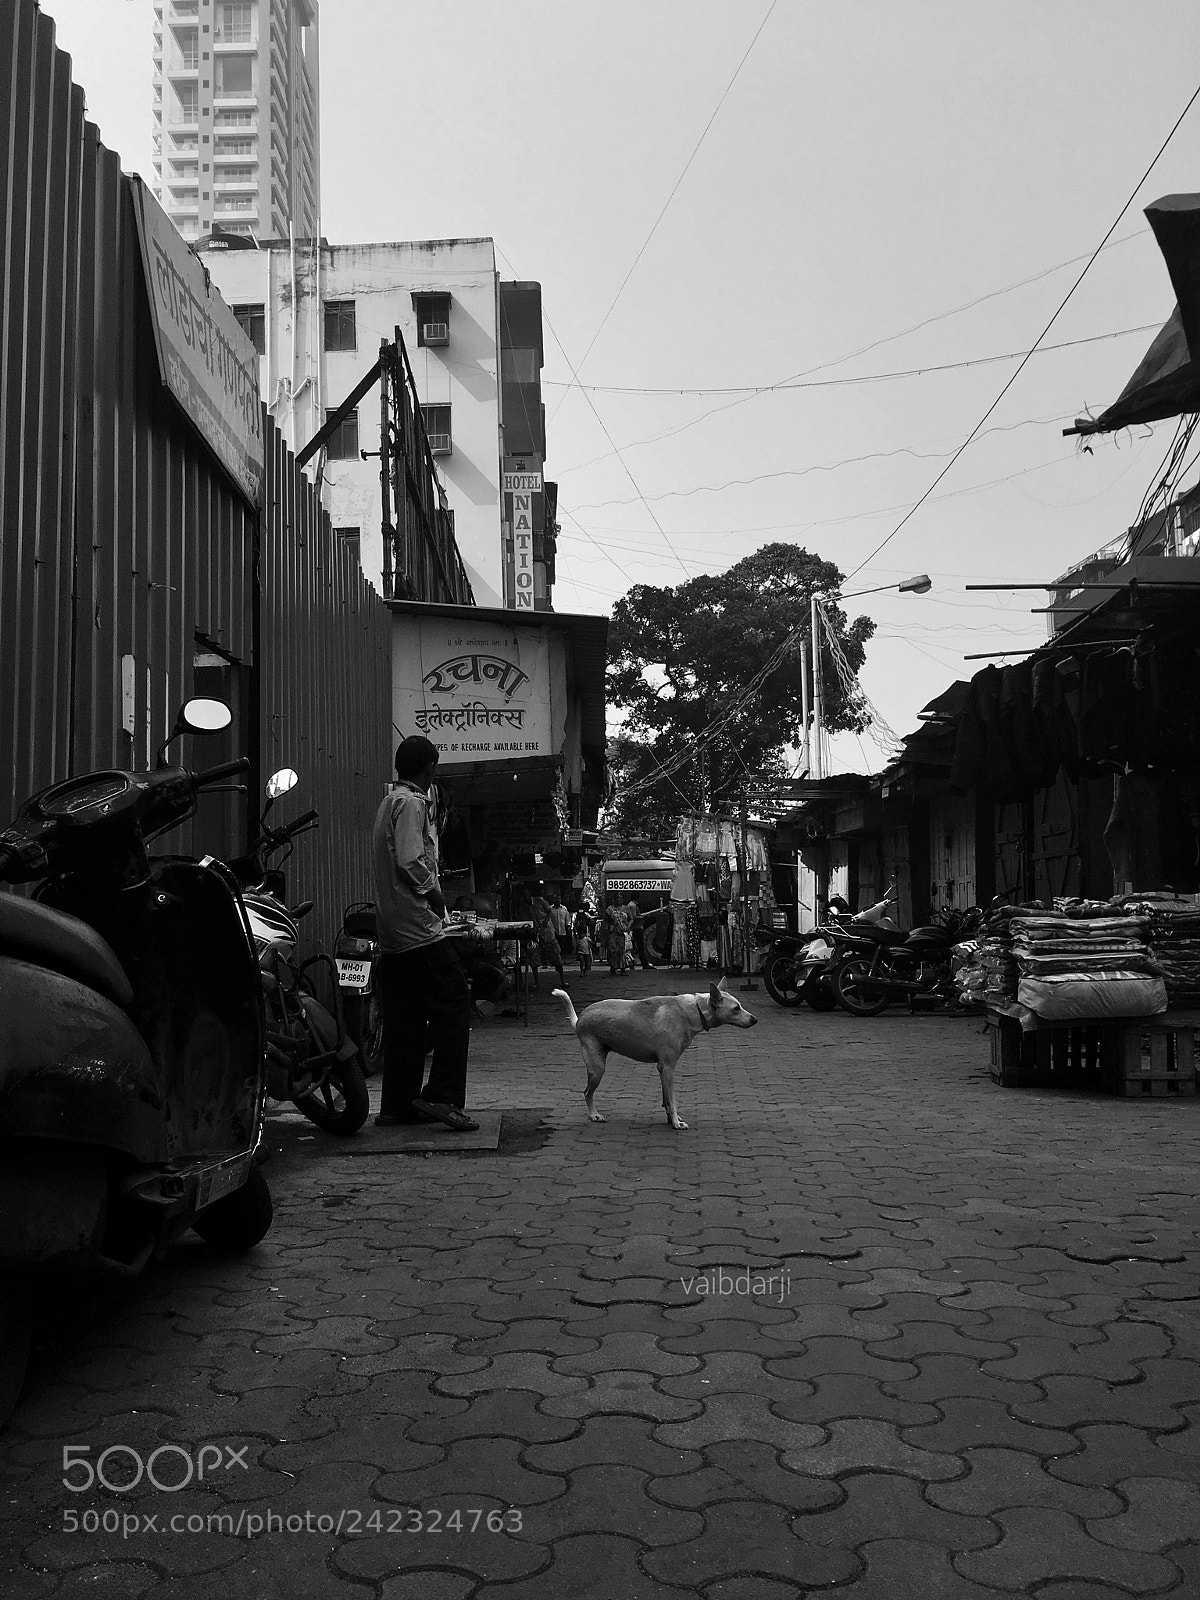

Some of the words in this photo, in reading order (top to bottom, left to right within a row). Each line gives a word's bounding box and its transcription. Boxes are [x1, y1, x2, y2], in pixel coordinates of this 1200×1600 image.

[504, 475, 541, 490] HOTEL
[514, 494, 533, 608] NATION
[422, 654, 530, 699] रचना
[414, 701, 525, 733] इलेक्ट्रॉनिक्स
[433, 743, 448, 752] YPES
[450, 743, 459, 752] OF
[461, 742, 491, 752] RECHARGE
[493, 741, 523, 751] AVAILABLE
[524, 741, 540, 751] HERE
[341, 962, 364, 972] MH-01
